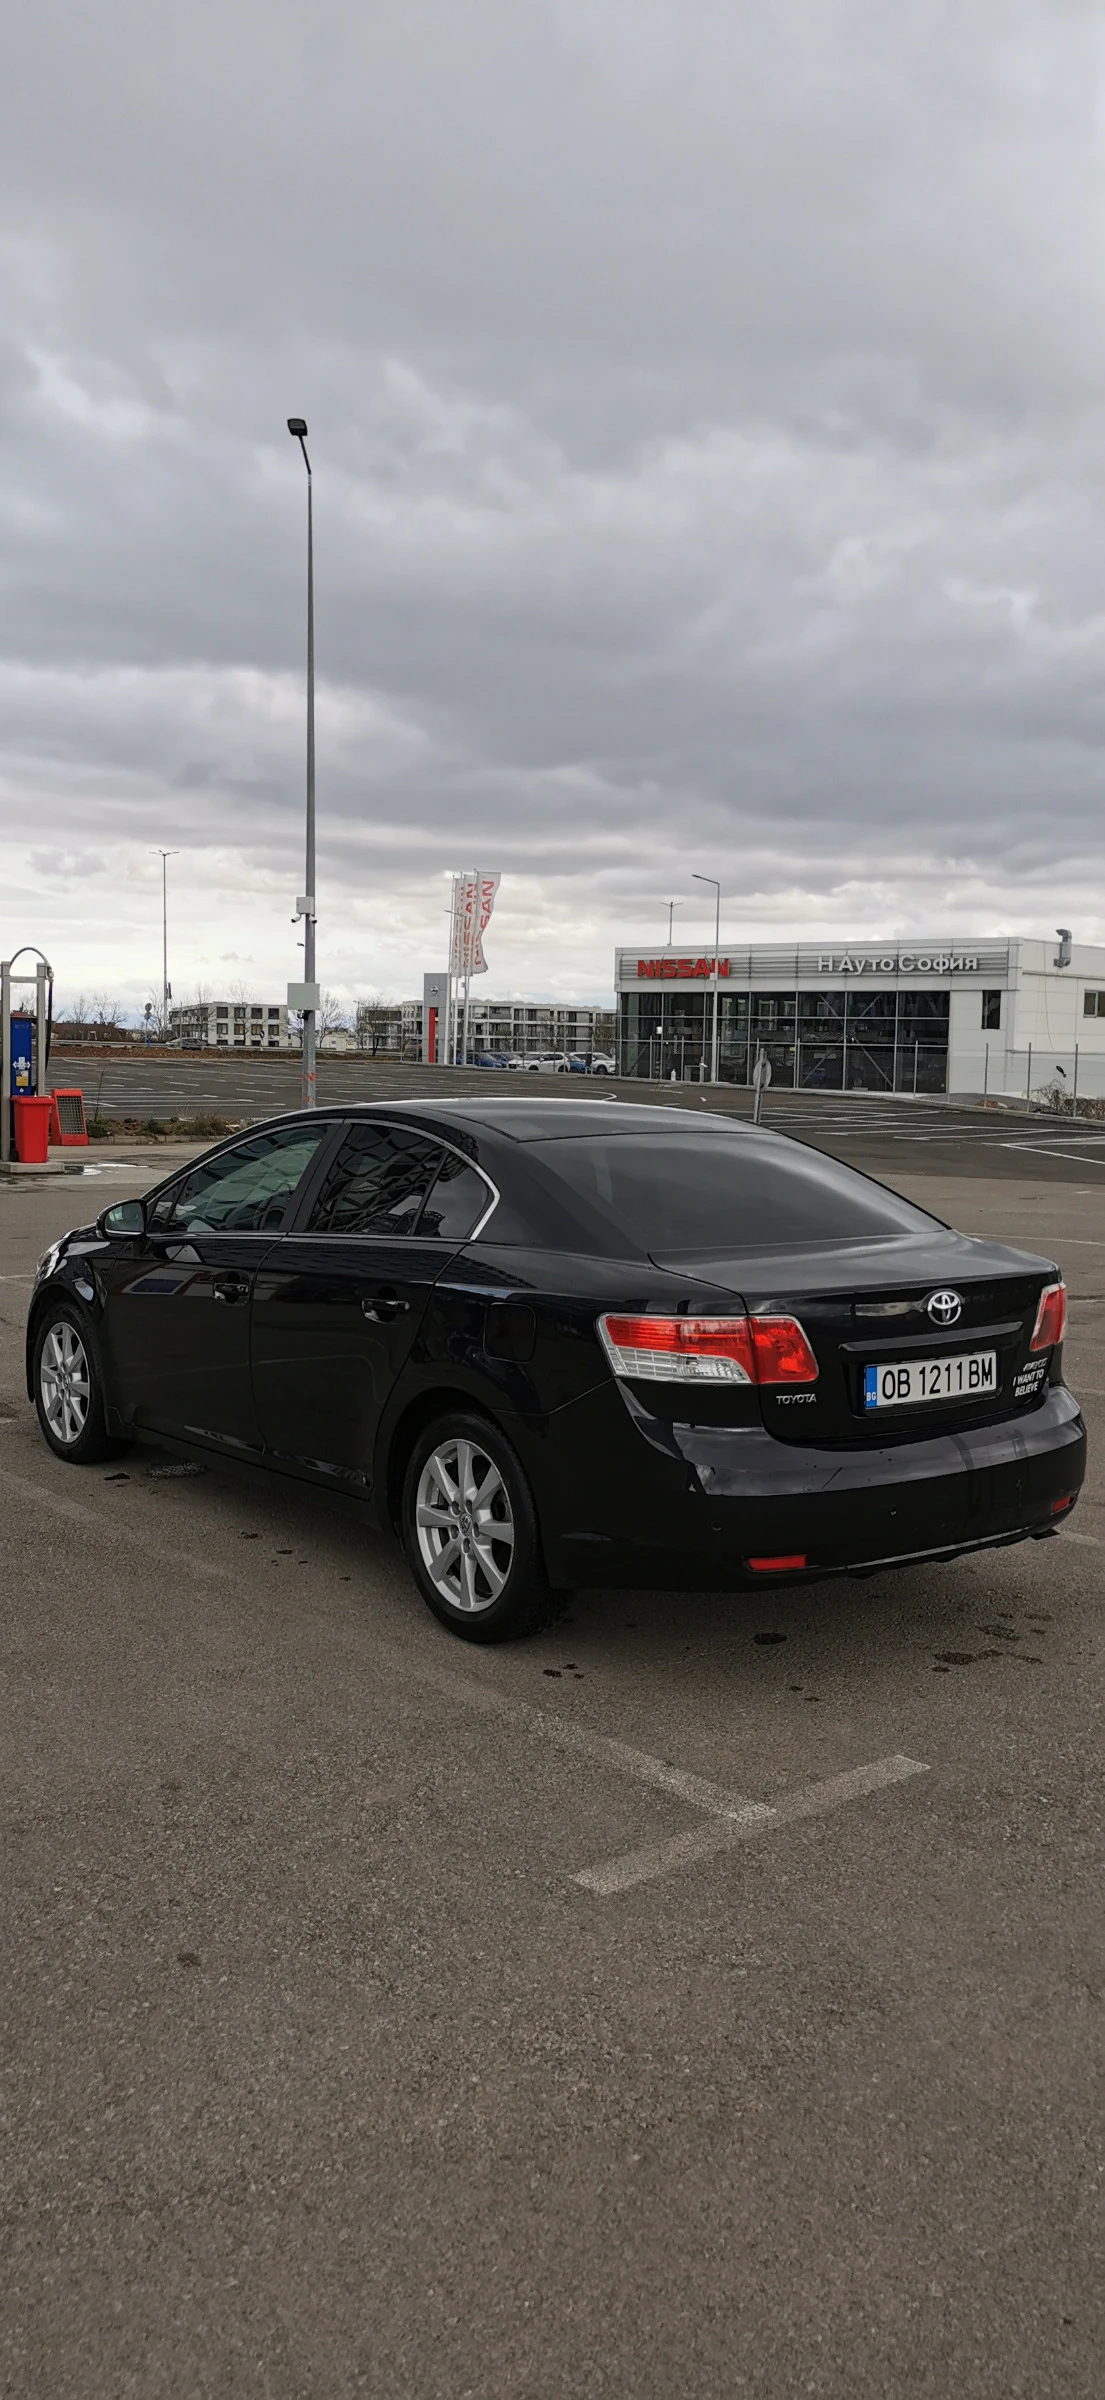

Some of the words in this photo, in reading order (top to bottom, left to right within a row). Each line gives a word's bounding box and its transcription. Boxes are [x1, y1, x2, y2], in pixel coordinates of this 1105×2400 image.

[475, 880, 495, 966] NSAN
[637, 958, 729, 979] NISSAN
[866, 1391, 877, 1401] BG
[1014, 1380, 1040, 1397] BELIEVE
[775, 1393, 818, 1405] TOYOTA
